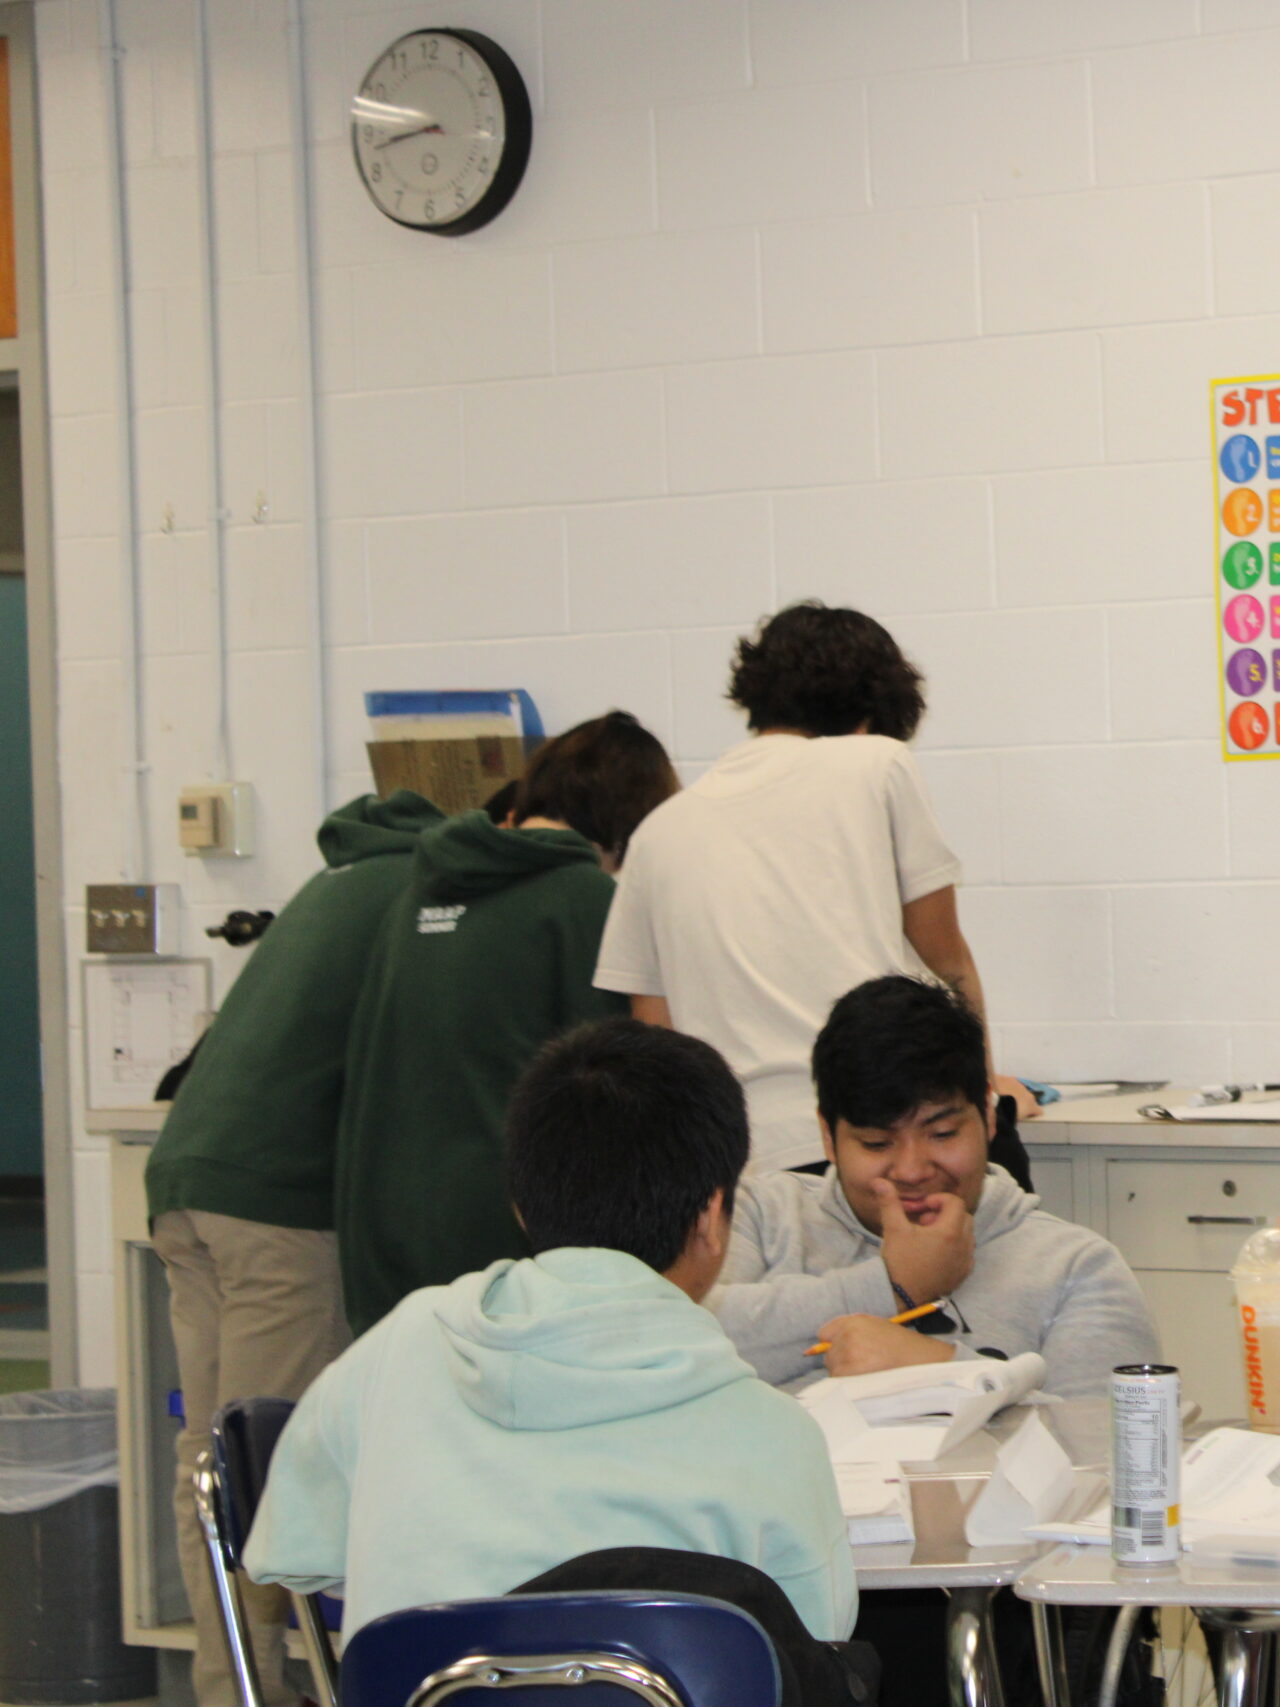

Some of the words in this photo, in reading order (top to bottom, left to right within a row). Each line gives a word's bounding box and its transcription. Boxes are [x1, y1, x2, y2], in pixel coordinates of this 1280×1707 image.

[421, 39, 438, 60] 12
[456, 51, 464, 69] 1
[364, 124, 374, 144] 9
[371, 162, 382, 182] 8
[423, 199, 435, 220] 6
[1241, 1304, 1267, 1415] DUNKIN'
[1113, 1384, 1147, 1395] CELSIUS
